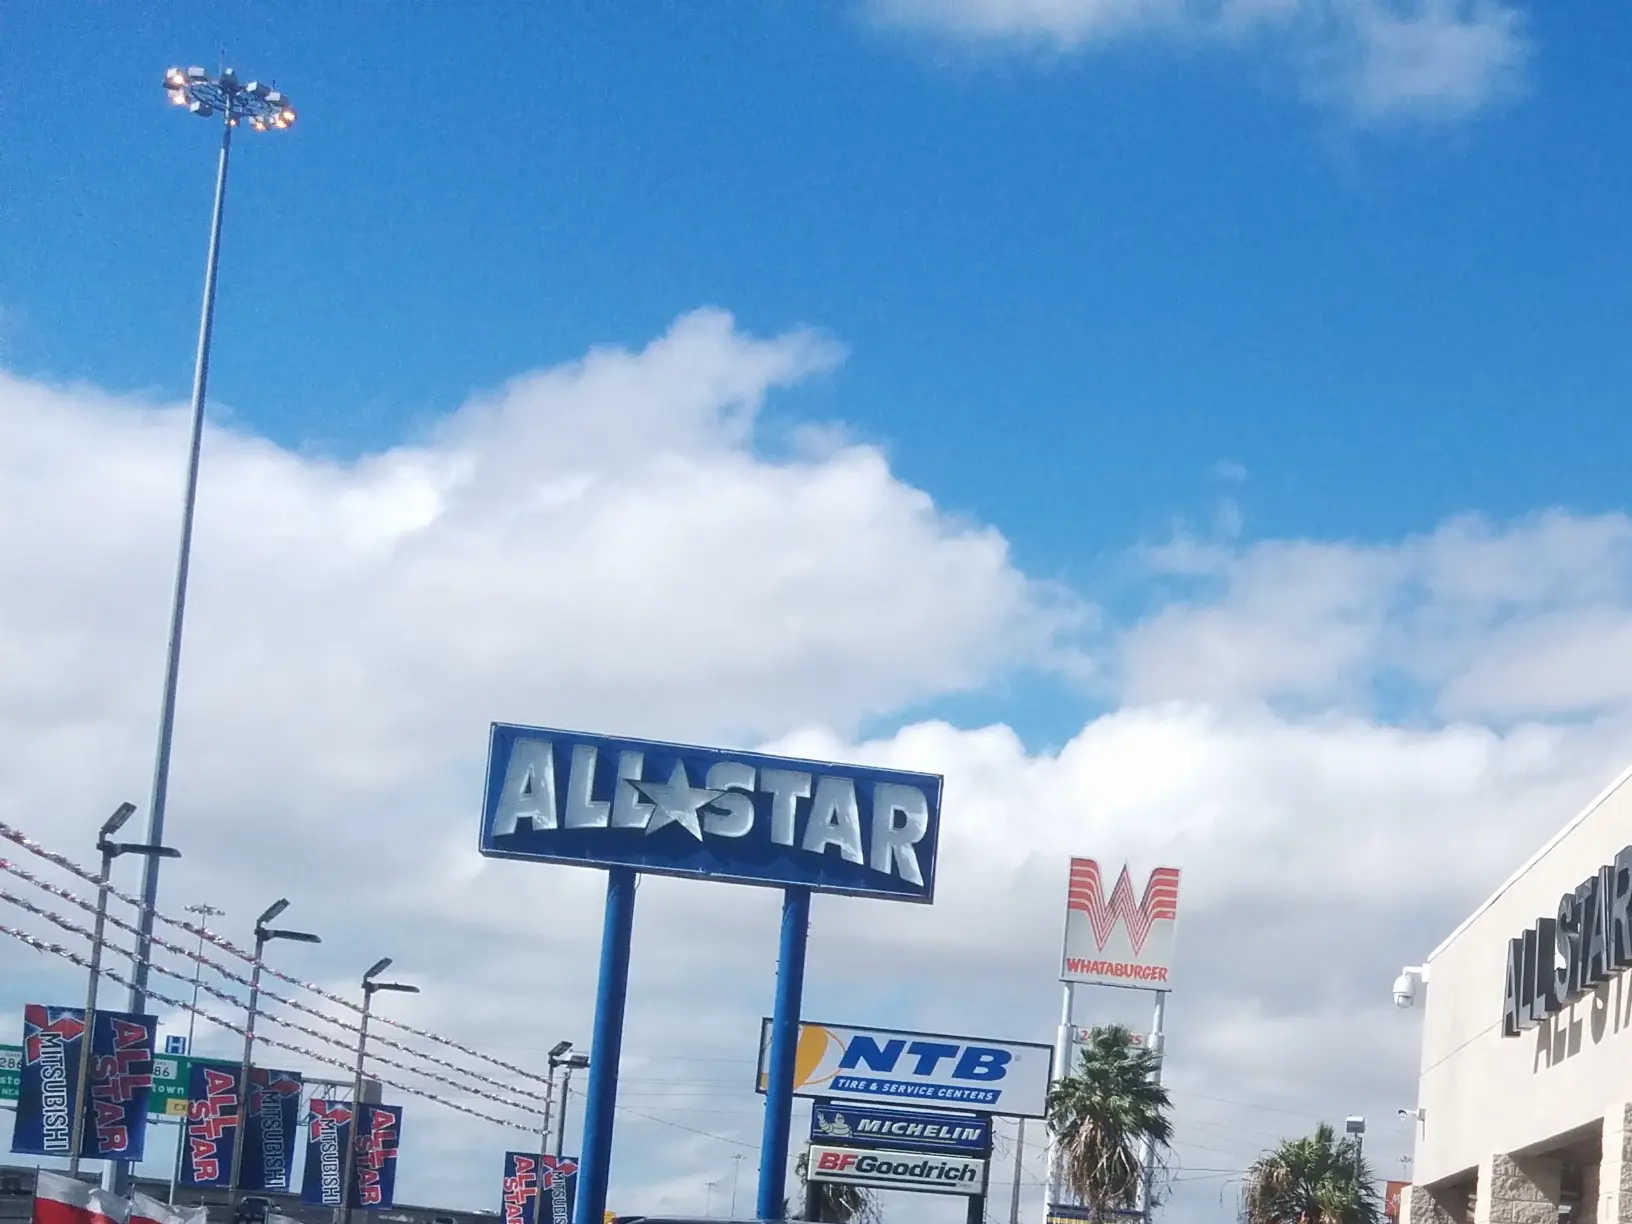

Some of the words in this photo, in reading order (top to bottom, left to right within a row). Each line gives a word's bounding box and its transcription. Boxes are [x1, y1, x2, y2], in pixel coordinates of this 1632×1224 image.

[492, 738, 656, 837] ALL
[703, 762, 929, 887] STAR
[1066, 958, 1168, 983] WHATABURGER
[1501, 918, 1562, 1038] ALL
[39, 1031, 69, 1151] MITSUBISHI
[110, 1017, 153, 1101] ALL
[837, 1078, 867, 1090] TIRE
[869, 1082, 878, 1091] &
[882, 1083, 933, 1096] SERVICE
[938, 1088, 994, 1100] CENTERS
[838, 1035, 1013, 1082] NTB
[89, 1054, 129, 1153] STAR
[203, 1068, 238, 1140] ALL
[260, 1089, 286, 1189] MITSUBISHI
[370, 1108, 399, 1169] ALL
[857, 1118, 982, 1141] MICHELIN
[187, 1099, 219, 1182] STAR
[320, 1117, 341, 1205] MITSUBISHI
[355, 1134, 382, 1206] STAR
[818, 1152, 977, 1182] BFGoodrich
[514, 1155, 538, 1204] ALL
